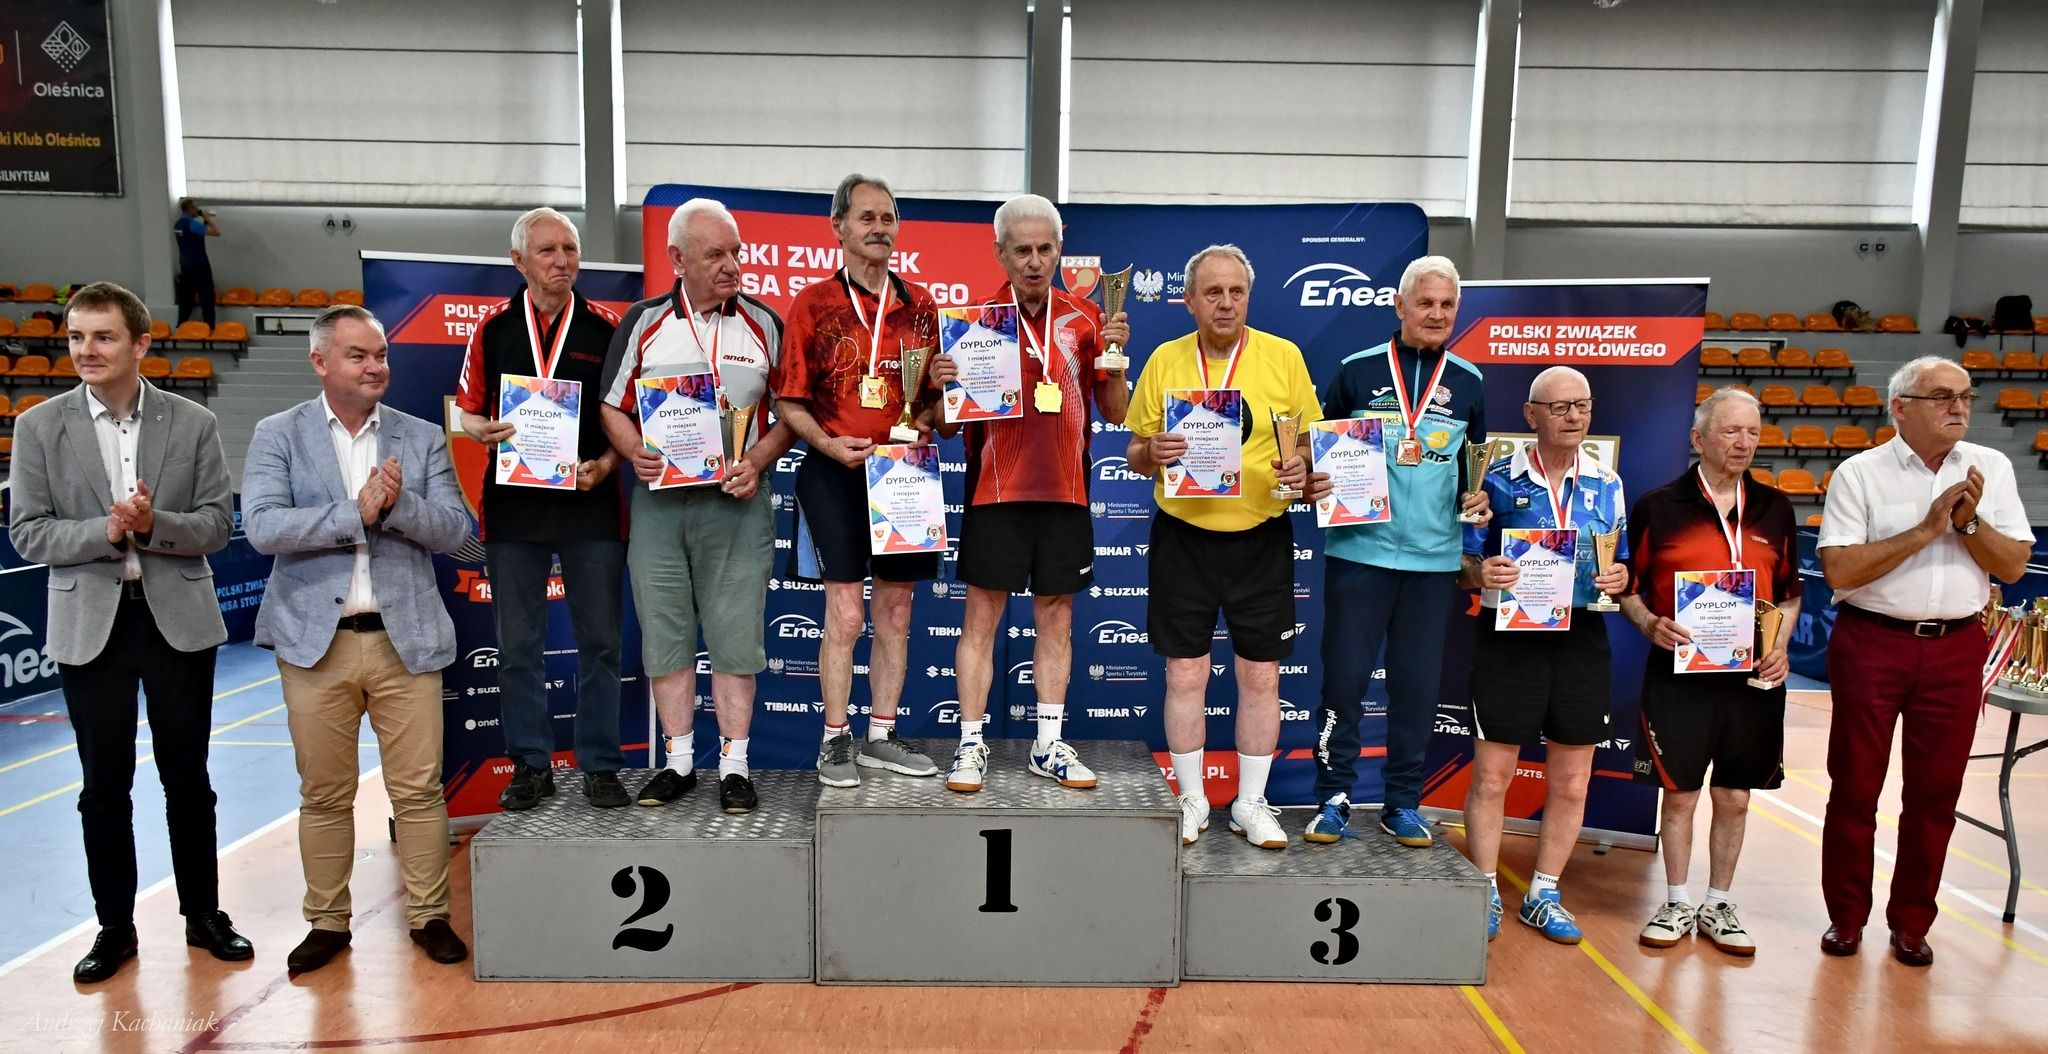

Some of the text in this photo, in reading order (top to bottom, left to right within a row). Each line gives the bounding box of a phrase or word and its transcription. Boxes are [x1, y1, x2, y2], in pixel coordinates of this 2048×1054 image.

[33, 81, 105, 98] Oleśnica
[14, 132, 43, 146] Klub
[45, 133, 101, 147] Oleśnica
[327, 219, 336, 227] A
[1859, 243, 1869, 251] C
[1875, 243, 1885, 251] D
[1065, 258, 1096, 267] PZTS
[1300, 280, 1398, 307] Enea
[1490, 325, 1637, 342] POLSKI ZWIĄZEK
[960, 339, 1002, 350] DYPLOM
[1489, 342, 1667, 357] TENISA STOŁOWEGO
[722, 353, 755, 364] andro
[971, 355, 996, 363] miejsca
[519, 408, 562, 419] DYPLOM
[659, 406, 701, 418] DYPLOM
[672, 422, 697, 430] miejsca
[1183, 421, 1224, 429] DYPLOM
[1330, 449, 1370, 459] DYPLOM
[885, 476, 926, 485] DYPLOM
[1519, 559, 1559, 567] DYPLOM
[1695, 601, 1737, 609] DYPLOM
[1098, 629, 1148, 644] Enea
[765, 702, 808, 712] TIBHAR
[1087, 708, 1130, 717] TIBHAR
[478, 718, 499, 728] onet
[978, 829, 1018, 912] 1
[611, 865, 673, 951] 2
[1309, 897, 1360, 966] 3
